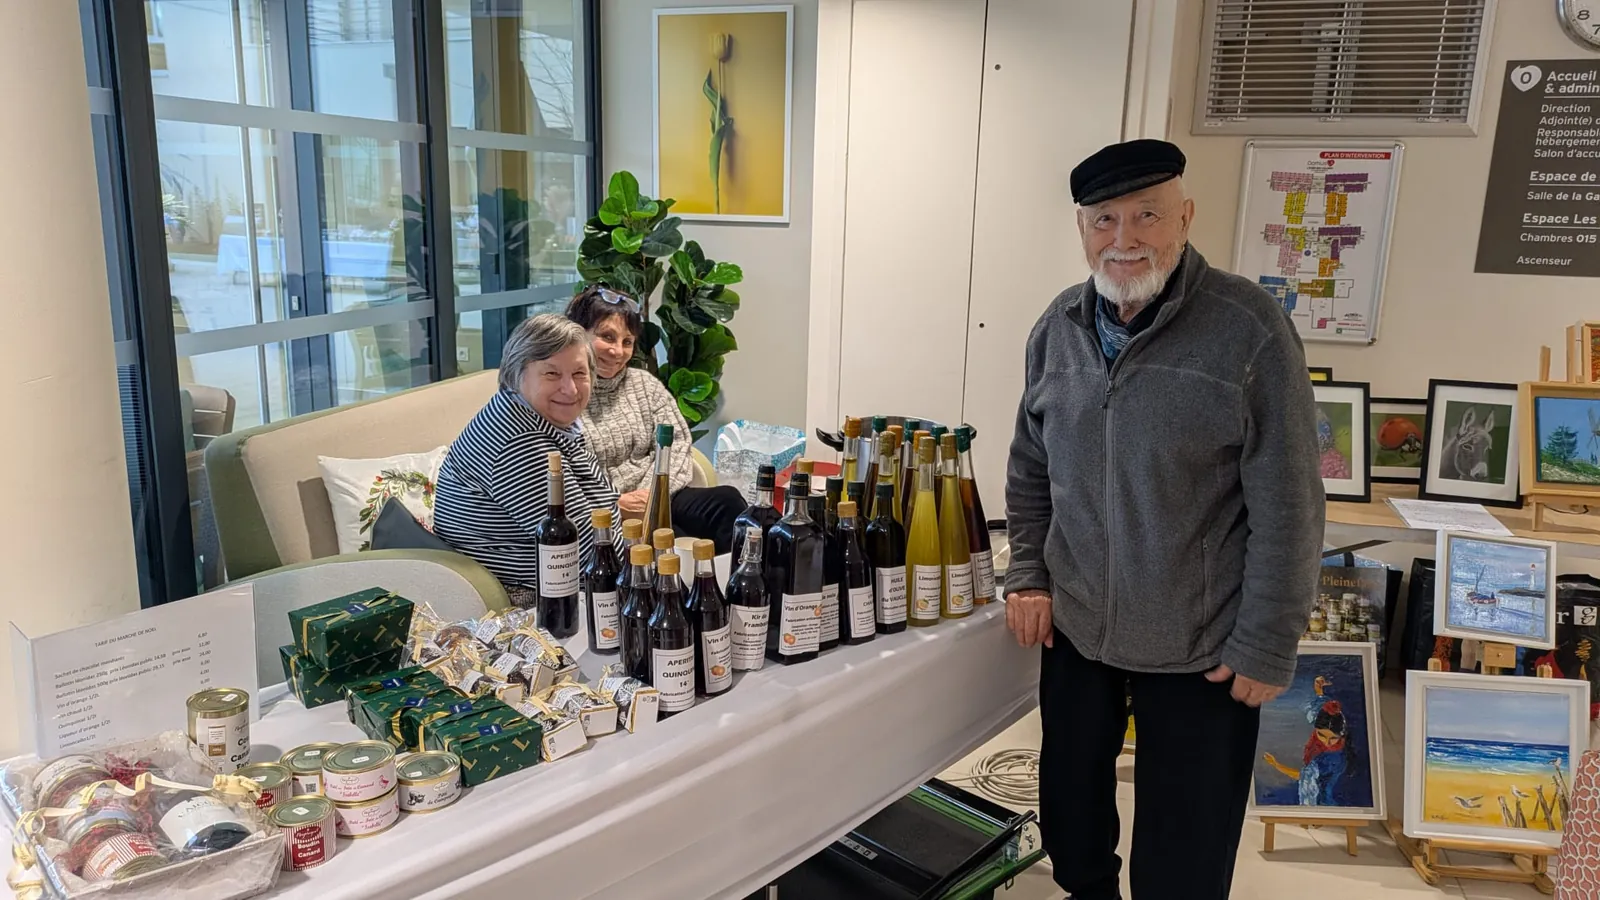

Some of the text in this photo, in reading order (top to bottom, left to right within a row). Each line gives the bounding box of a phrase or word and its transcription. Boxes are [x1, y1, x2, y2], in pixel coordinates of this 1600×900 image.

[1577, 9, 1590, 20] 8
[1592, 24, 1600, 35] 7
[1547, 70, 1597, 81] Accueil
[1544, 83, 1555, 94] &
[1541, 104, 1591, 113] Direction
[1539, 116, 1593, 126] Adjoint(e)
[1534, 148, 1564, 158] Salon
[1529, 171, 1597, 182] Espace de
[1527, 191, 1553, 200] Salle
[1555, 191, 1569, 200] de
[1571, 192, 1582, 200] la
[1522, 213, 1597, 225] Espace Les
[1520, 233, 1597, 243] Chambres 015
[1516, 255, 1573, 265] Ascenseur
[297, 840, 321, 849] Boudin
[297, 848, 321, 858] Canard
